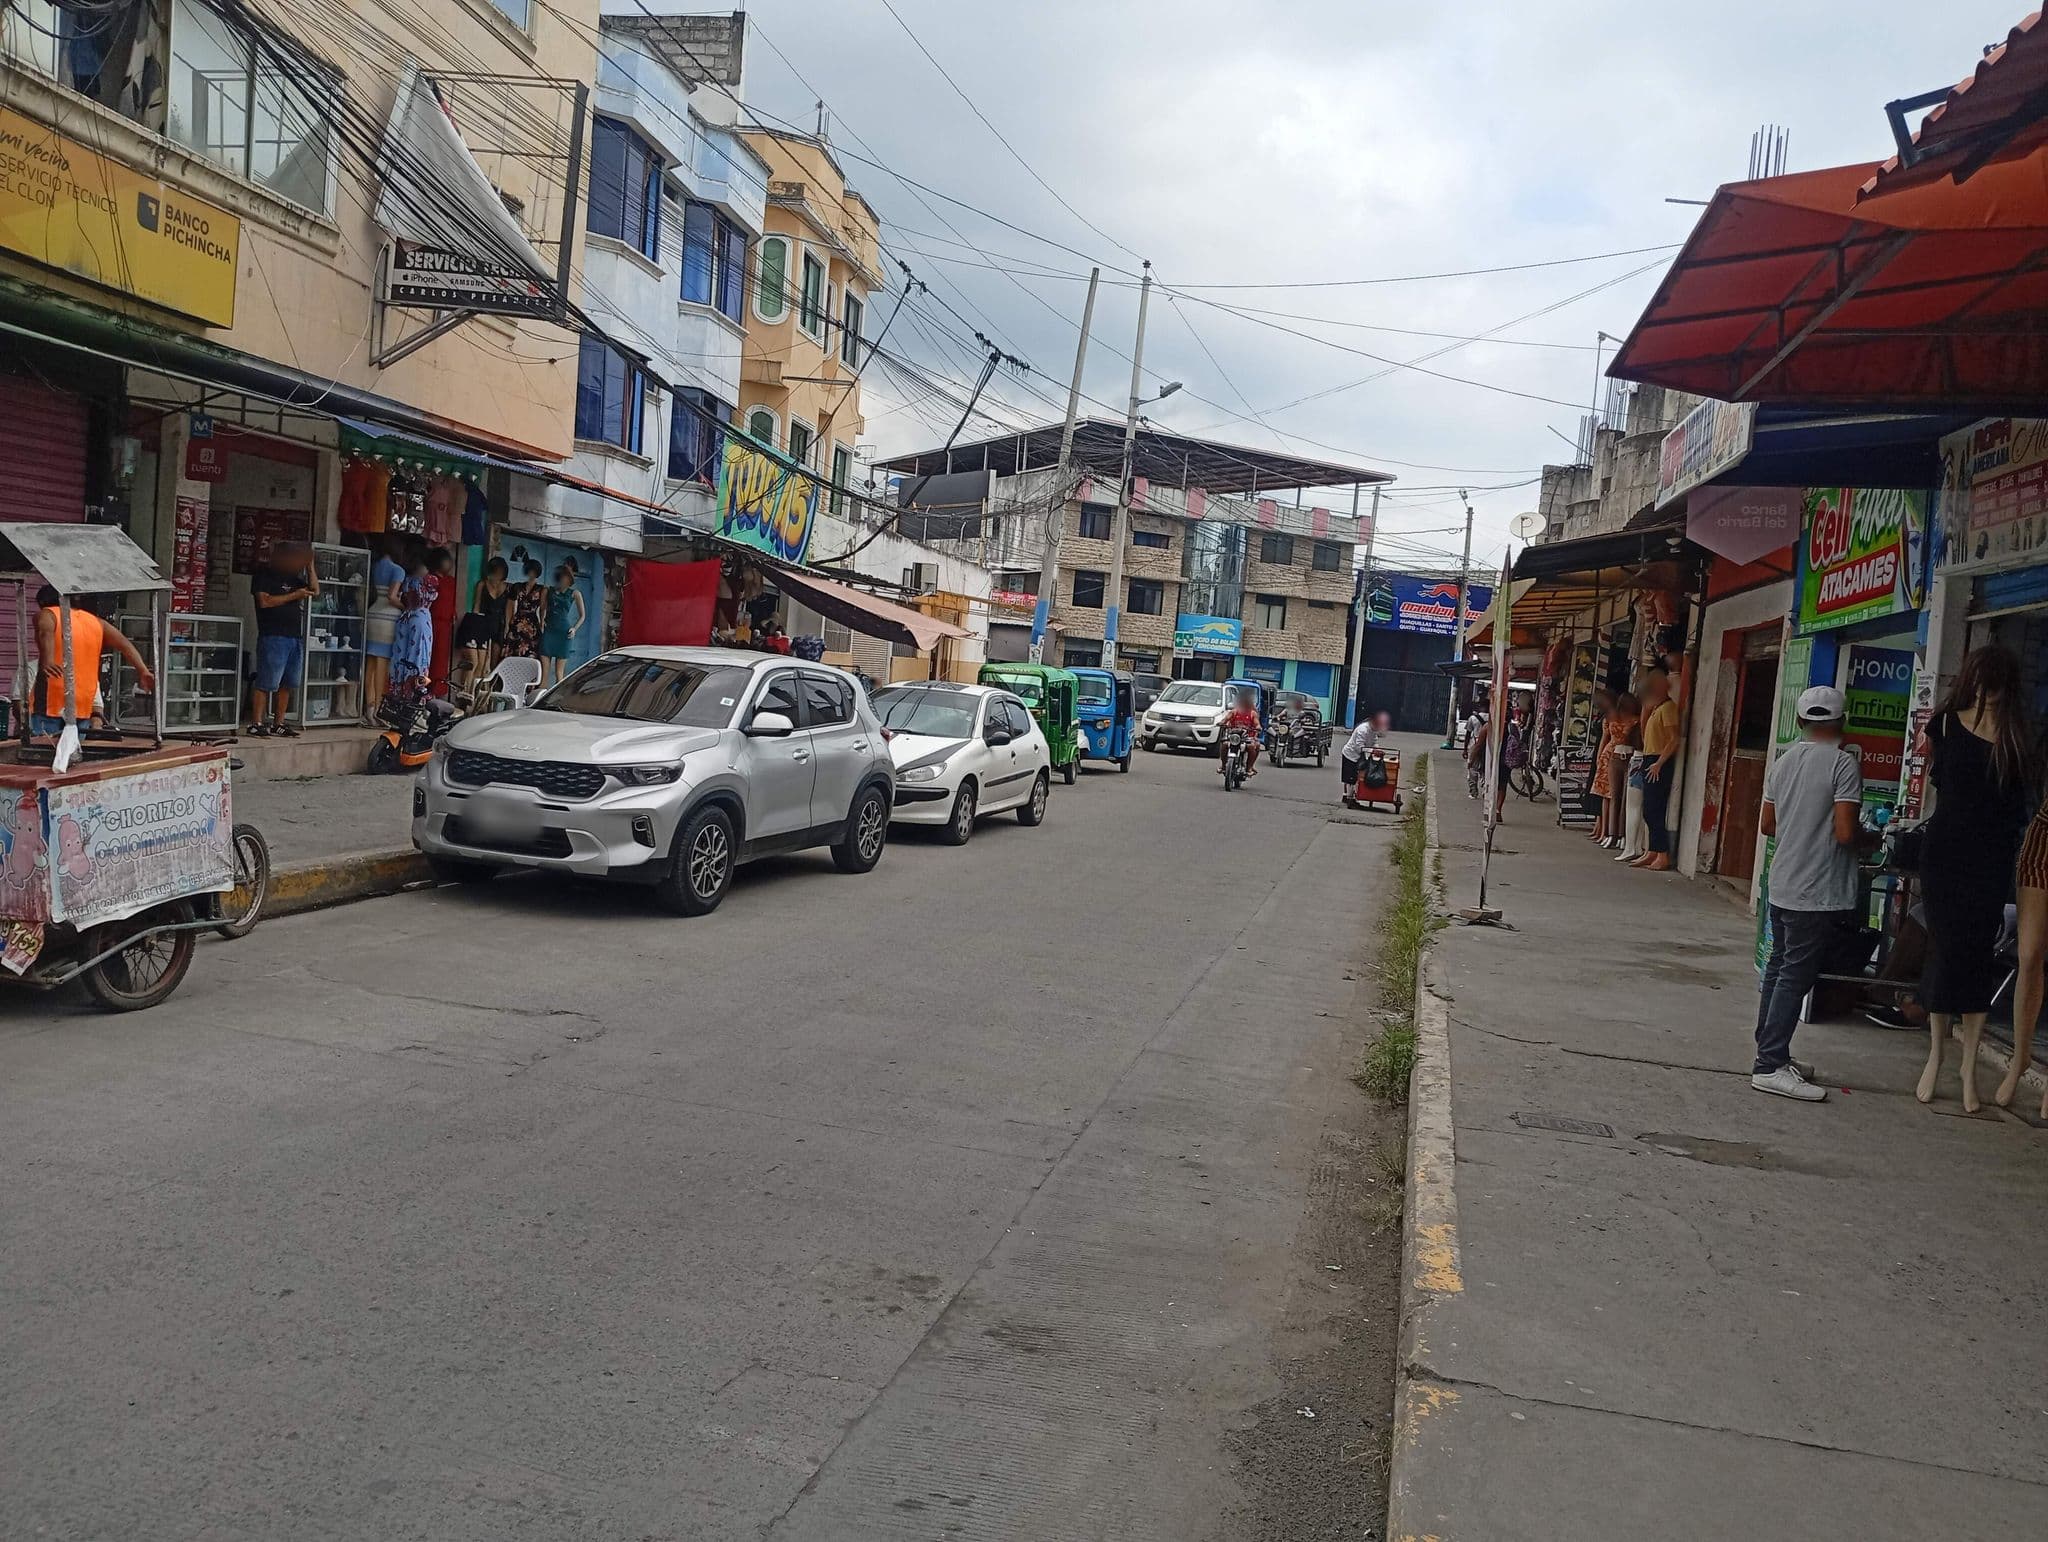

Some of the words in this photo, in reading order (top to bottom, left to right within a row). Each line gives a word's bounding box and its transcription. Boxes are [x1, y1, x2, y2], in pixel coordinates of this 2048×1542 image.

[0, 152, 62, 191] SERVICIO
[65, 181, 117, 215] TECNICO
[165, 204, 210, 235] BANCO
[163, 222, 231, 264] PICHINCHA
[405, 251, 477, 273] SERVICIO
[400, 287, 457, 299] CARLOS
[411, 273, 439, 285] iPhone
[450, 278, 485, 287] SAMSUNG
[1819, 552, 1895, 605] ATACAMES
[1855, 658, 1910, 681] HONO
[1863, 751, 1902, 766] xiaom
[104, 795, 195, 831] CHORIZOS
